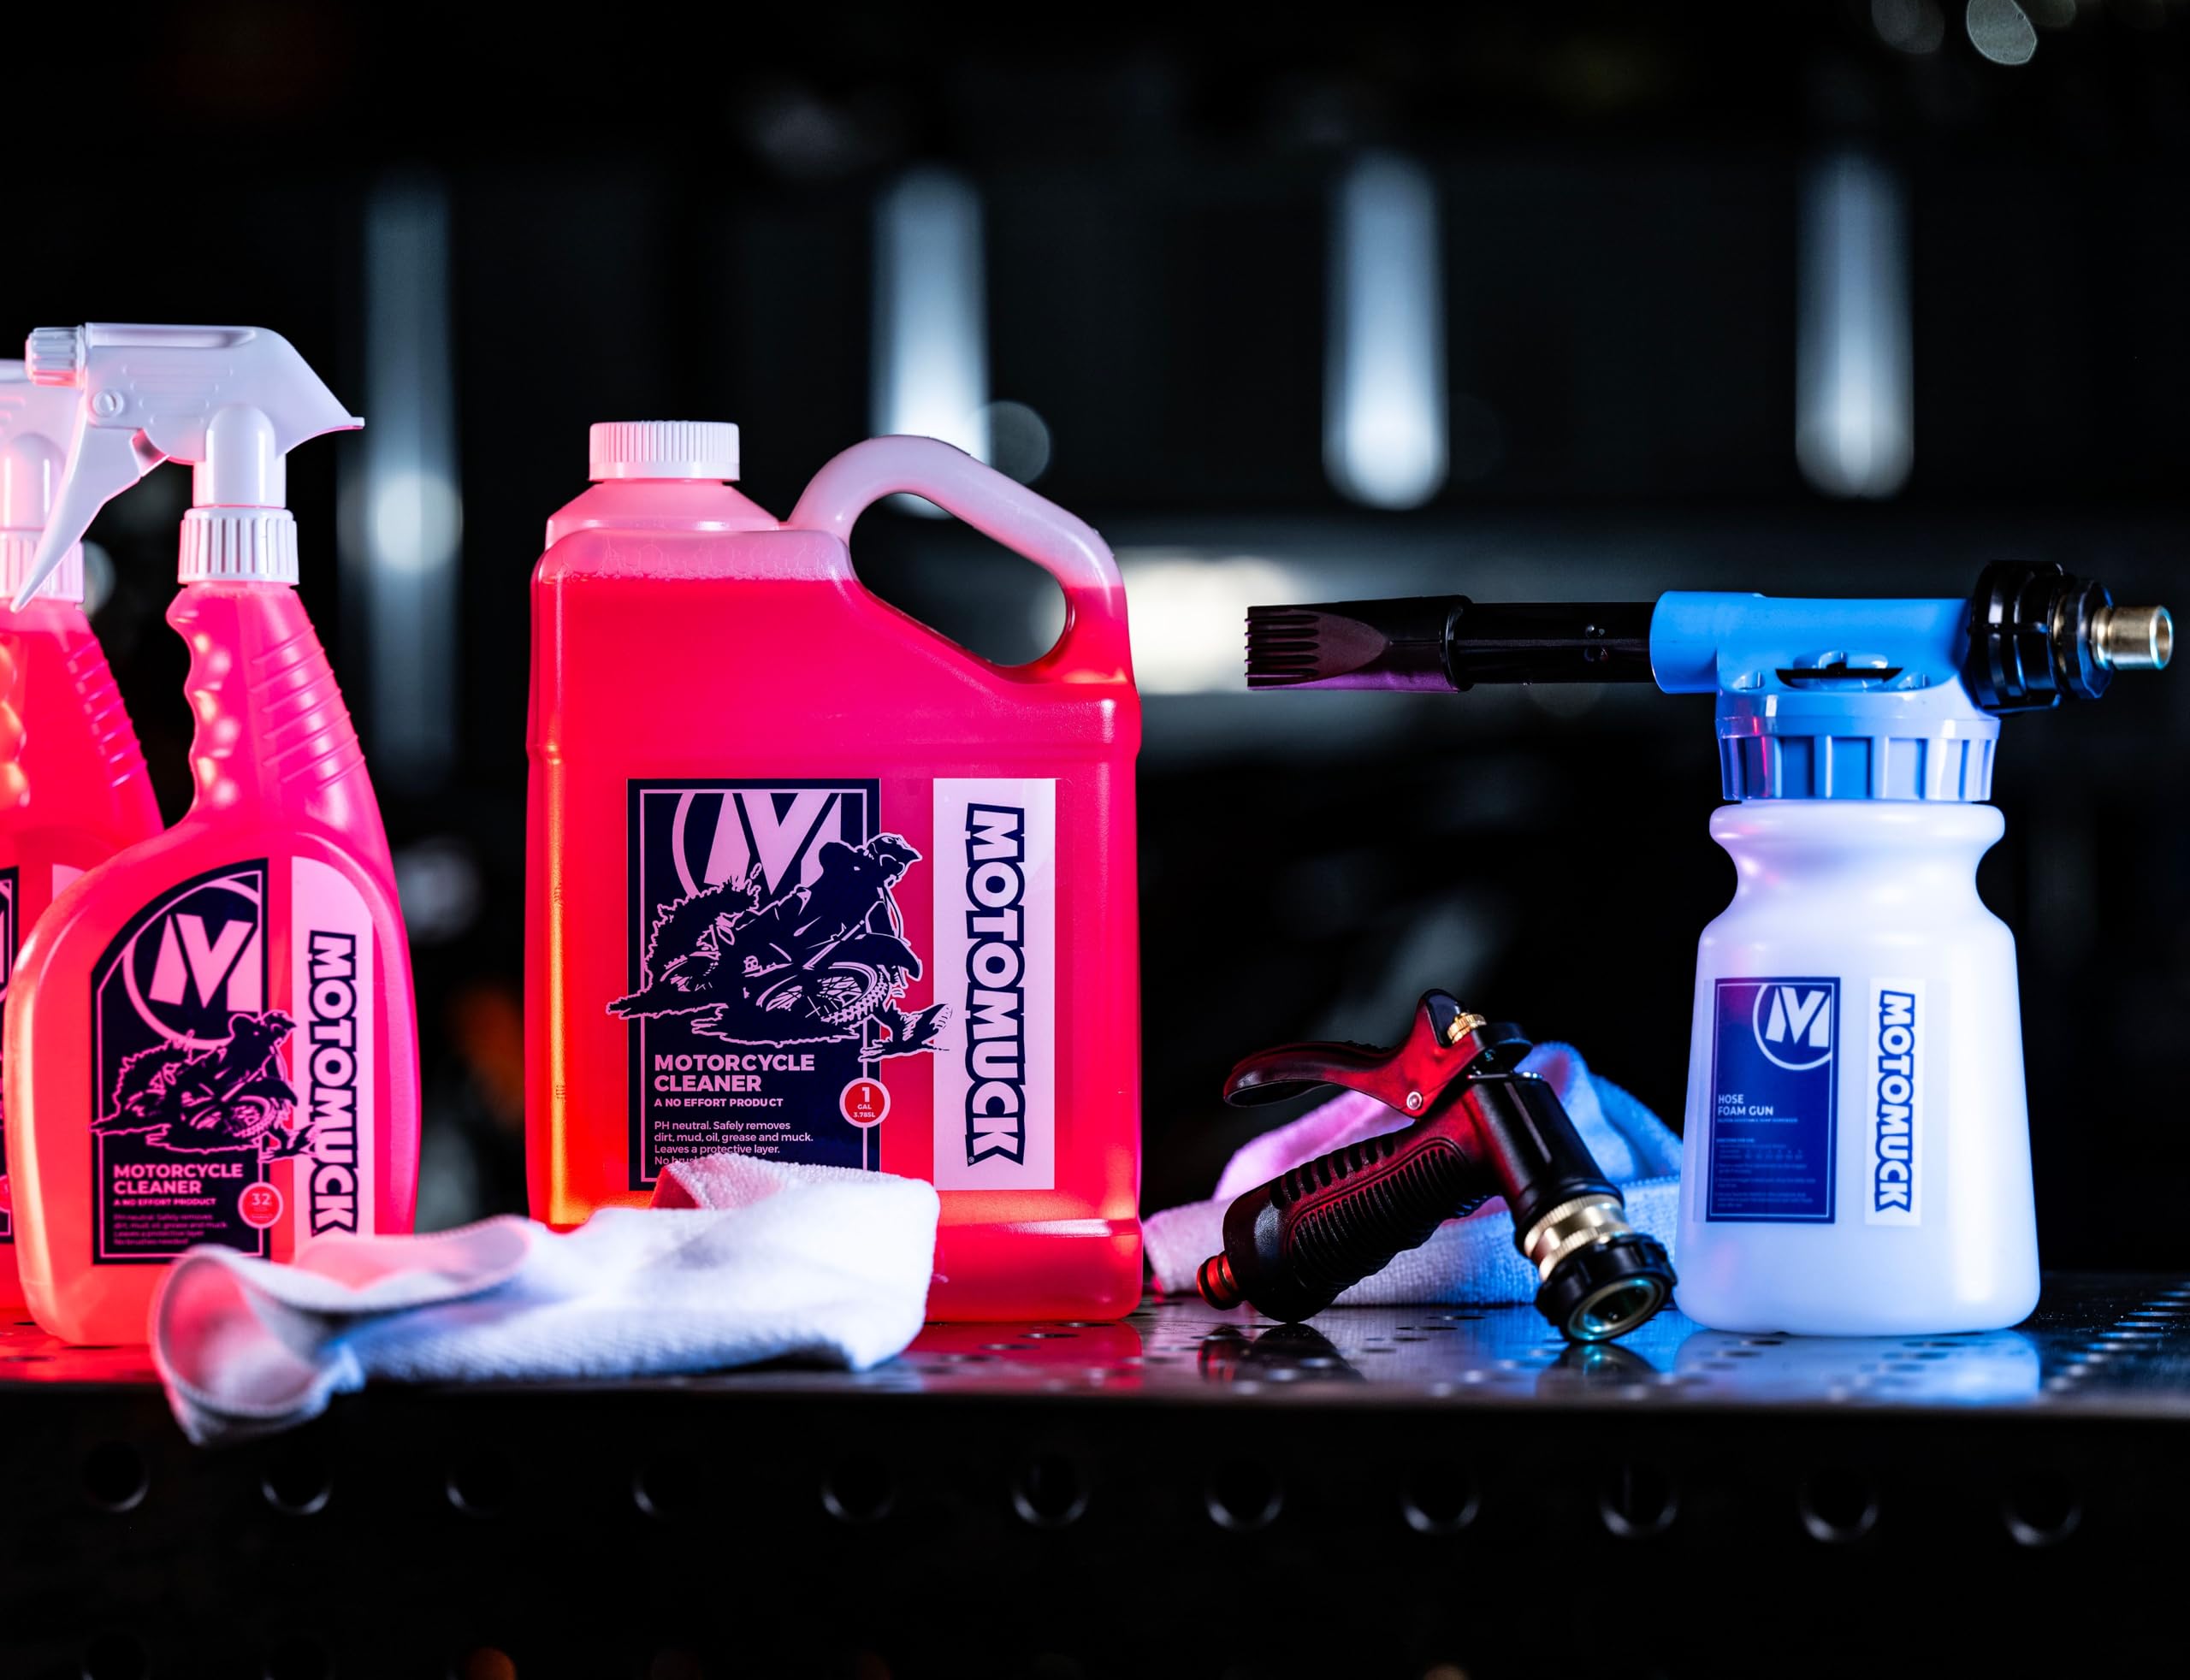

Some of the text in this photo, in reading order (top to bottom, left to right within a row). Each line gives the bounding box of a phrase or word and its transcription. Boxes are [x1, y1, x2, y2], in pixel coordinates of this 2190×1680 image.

[965, 802, 1026, 1167] MOTOMUCK
[654, 1054, 815, 1072] MOTORCYCLE
[309, 930, 358, 1237] MOTOMUCK
[654, 1074, 762, 1092] CLEANER
[861, 1086, 870, 1103] 1
[1718, 1094, 1744, 1104] HOSE
[654, 1098, 784, 1107] A NO EFFORT PRODUCT
[1874, 990, 1915, 1213] MOTOMUCK
[1718, 1106, 1773, 1115] FOAM GUN
[654, 1121, 670, 1130] PH
[672, 1121, 712, 1130] neutral.
[713, 1121, 743, 1132] Safely
[654, 1133, 814, 1144] dirt, mud, oil, grease and muck.
[654, 1145, 690, 1154] Leaves
[700, 1145, 752, 1155] protective
[754, 1145, 780, 1155] layer.
[654, 1156, 670, 1165] No
[113, 1163, 244, 1179] MOTORCYCLE
[113, 1180, 202, 1195] CLEANER
[173, 1198, 216, 1206] PRODUCT
[252, 1192, 271, 1205] 32
